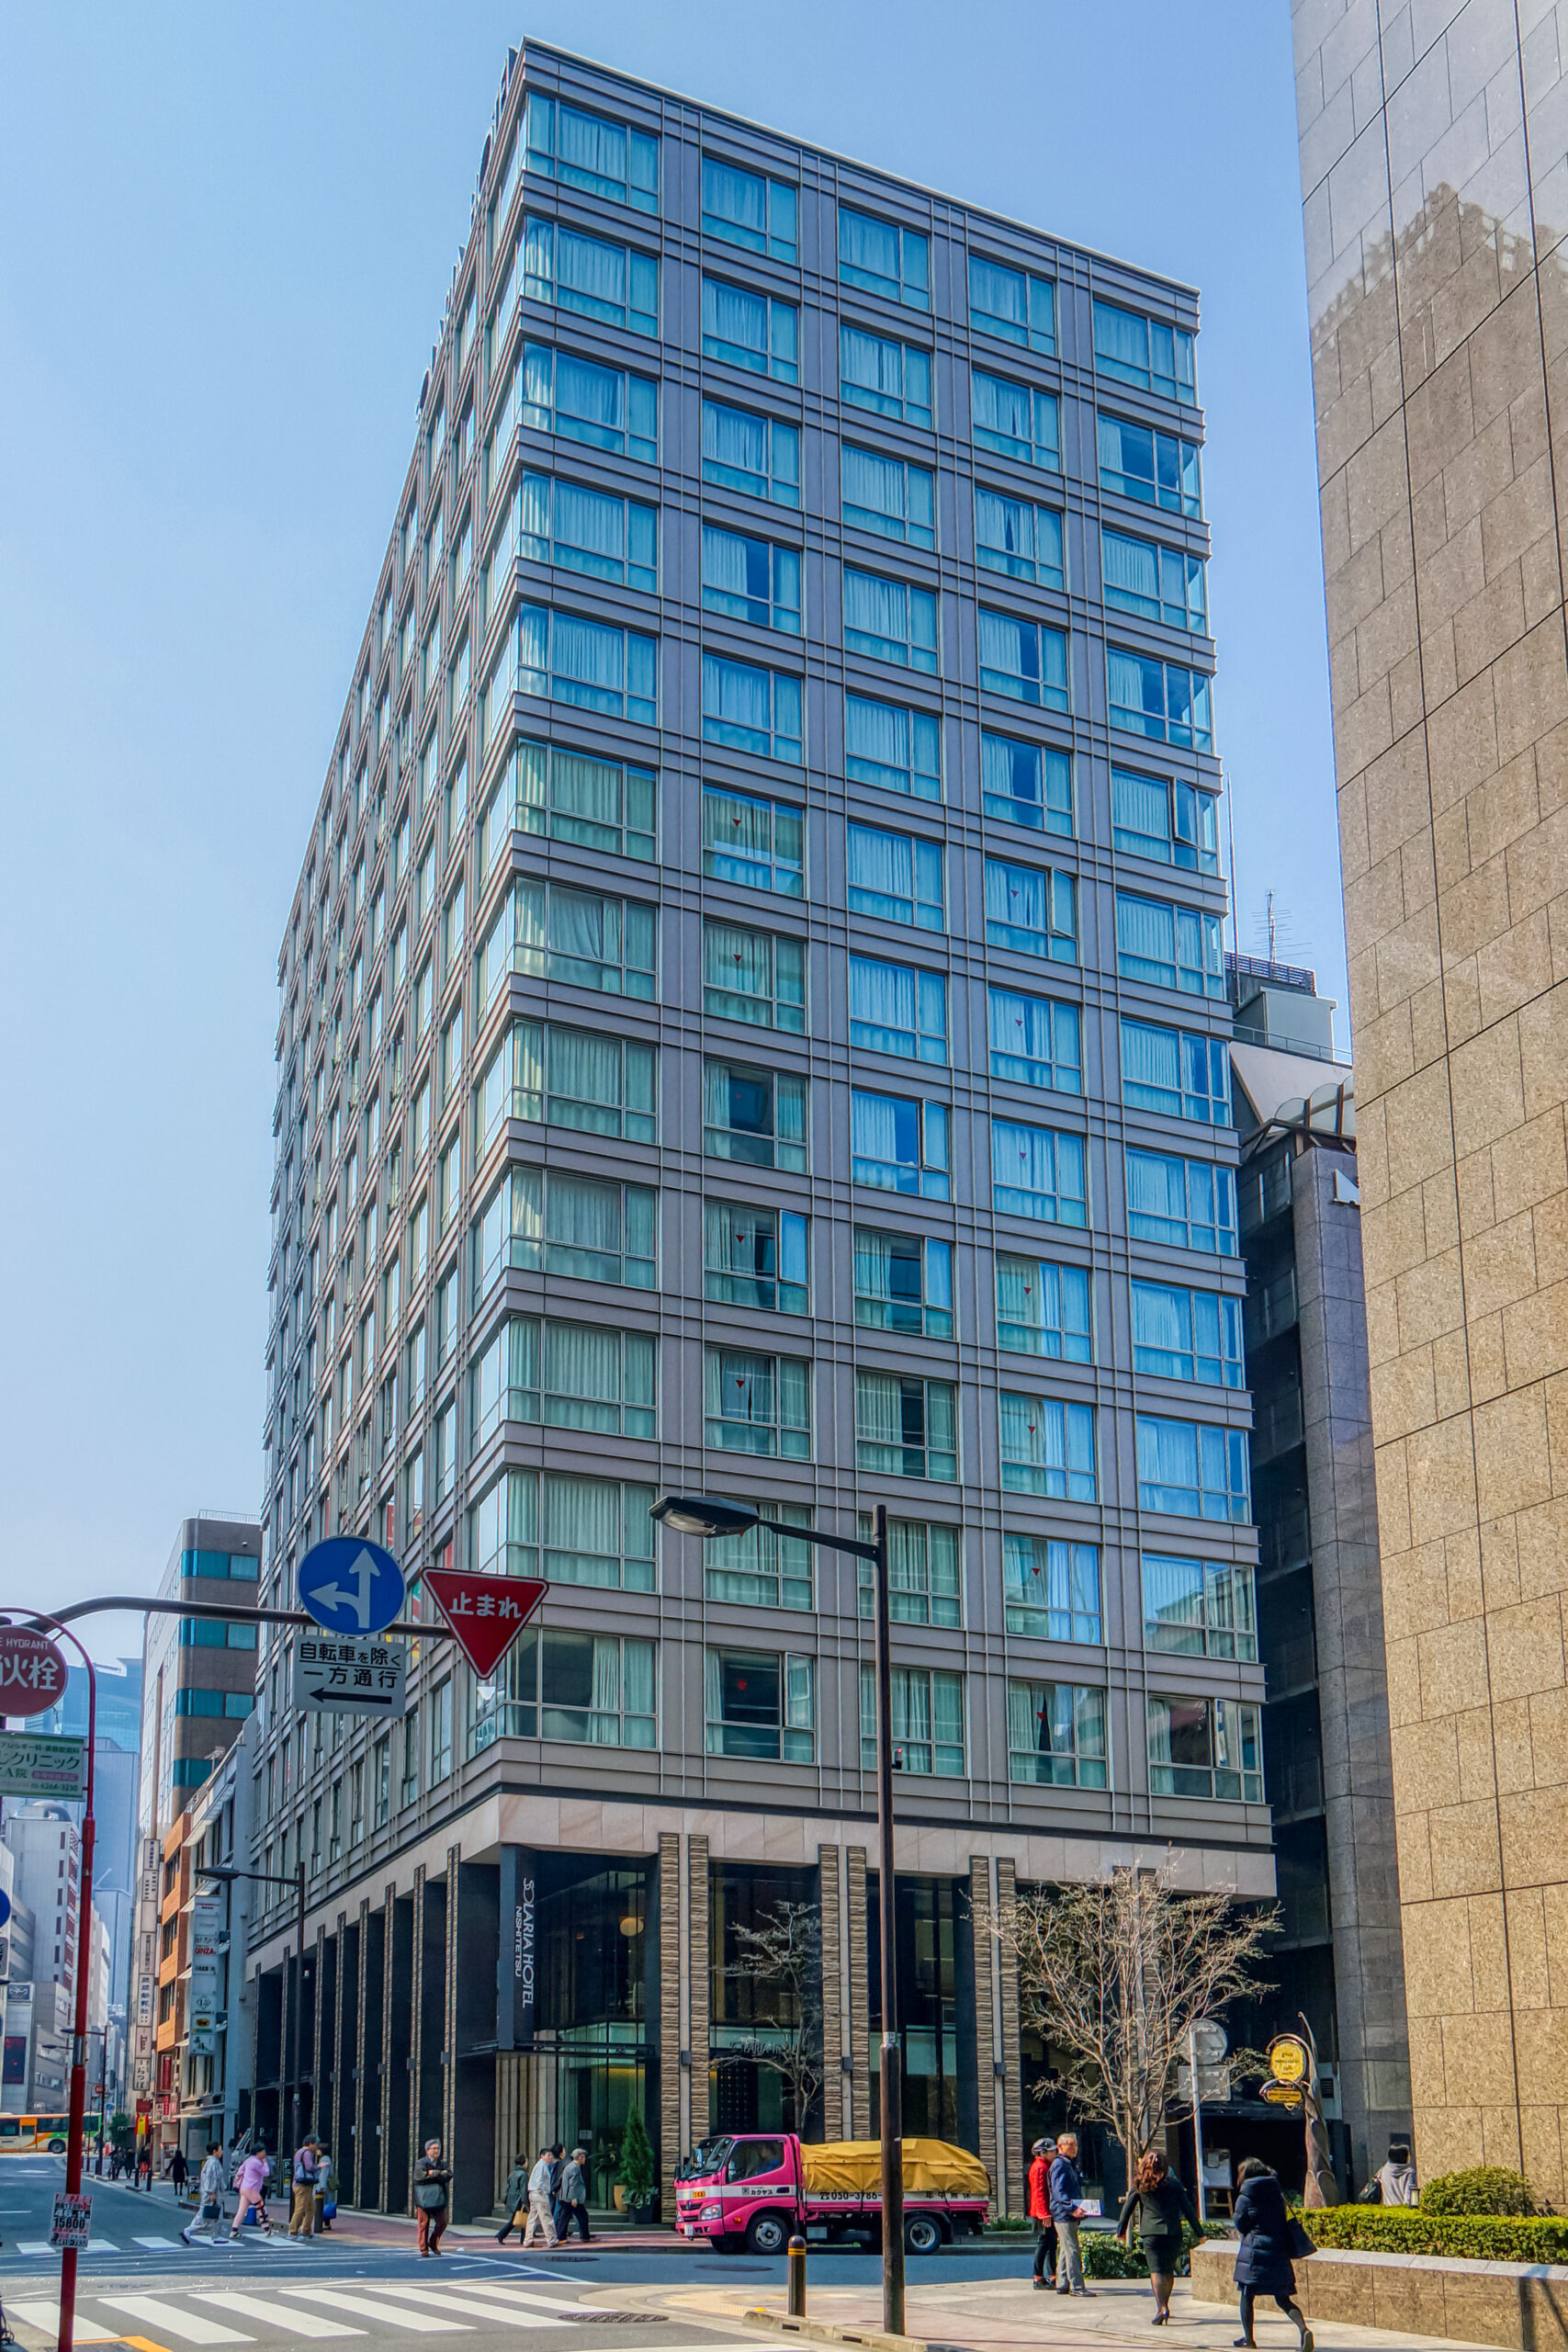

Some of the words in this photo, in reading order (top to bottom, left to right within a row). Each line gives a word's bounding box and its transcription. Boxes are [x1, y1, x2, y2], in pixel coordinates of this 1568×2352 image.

[449, 1591, 522, 1620] 止まれ
[6, 1638, 49, 1650] HYDRANT
[300, 1642, 400, 1667] 自転車を除く
[0, 1654, 59, 1690] 火栓
[303, 1667, 398, 1689] 一方通行
[523, 1877, 535, 1951] SOLARIA
[514, 1905, 523, 1978] NISHITETSU
[522, 1954, 534, 2008] HOTEL
[53, 2218, 85, 2229] 15800
